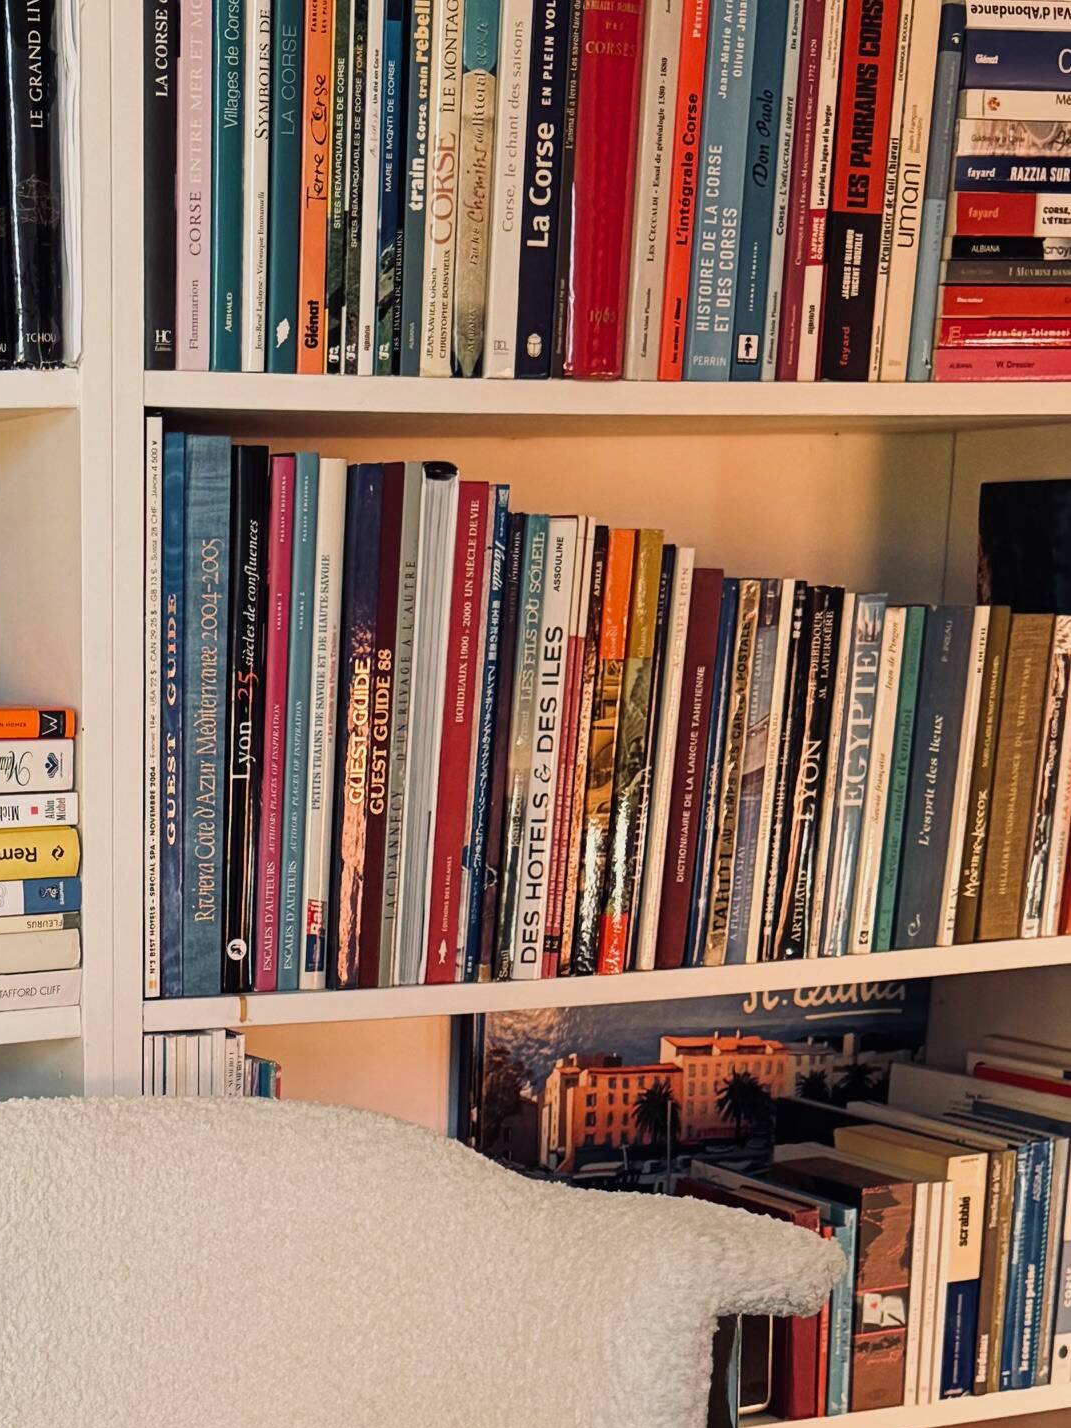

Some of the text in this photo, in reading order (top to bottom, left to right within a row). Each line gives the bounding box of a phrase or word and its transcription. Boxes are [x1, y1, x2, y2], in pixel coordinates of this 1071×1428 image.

[155, 10, 168, 97] LA CORSE
[224, 72, 240, 128] Villages
[225, 47, 239, 66] de
[305, 75, 328, 348] Glénat Terre Corse
[333, 58, 346, 229] SITES REMARQUABLES DE CORSE
[430, 87, 456, 245] CORSE ÎLE
[527, 36, 555, 247] La Corse EN PLEIN
[676, 93, 698, 245] L'intégrale Corse
[752, 90, 774, 187] Don Paolo
[840, 63, 879, 366] fayard LES PARRAINS
[896, 163, 922, 248] umani
[968, 167, 1070, 182] fayard RAZZIA SUR
[189, 192, 202, 350] Flammarion CORSE
[696, 144, 722, 331] HISTOIRE DE LA CORSE
[714, 208, 737, 331] ET DES CORSES
[230, 670, 258, 780] Lyon 25
[369, 649, 391, 814] GUEST GUIDE 88
[455, 663, 468, 722] BORDEAUX
[520, 536, 564, 963] DES HOTELS & DES ILES ASSOULINE
[837, 650, 879, 808] EGYPTE
[676, 666, 705, 882] DICTIONNAIRE DE LA LANGUE TAHITIENNE
[793, 740, 821, 822] LYON
